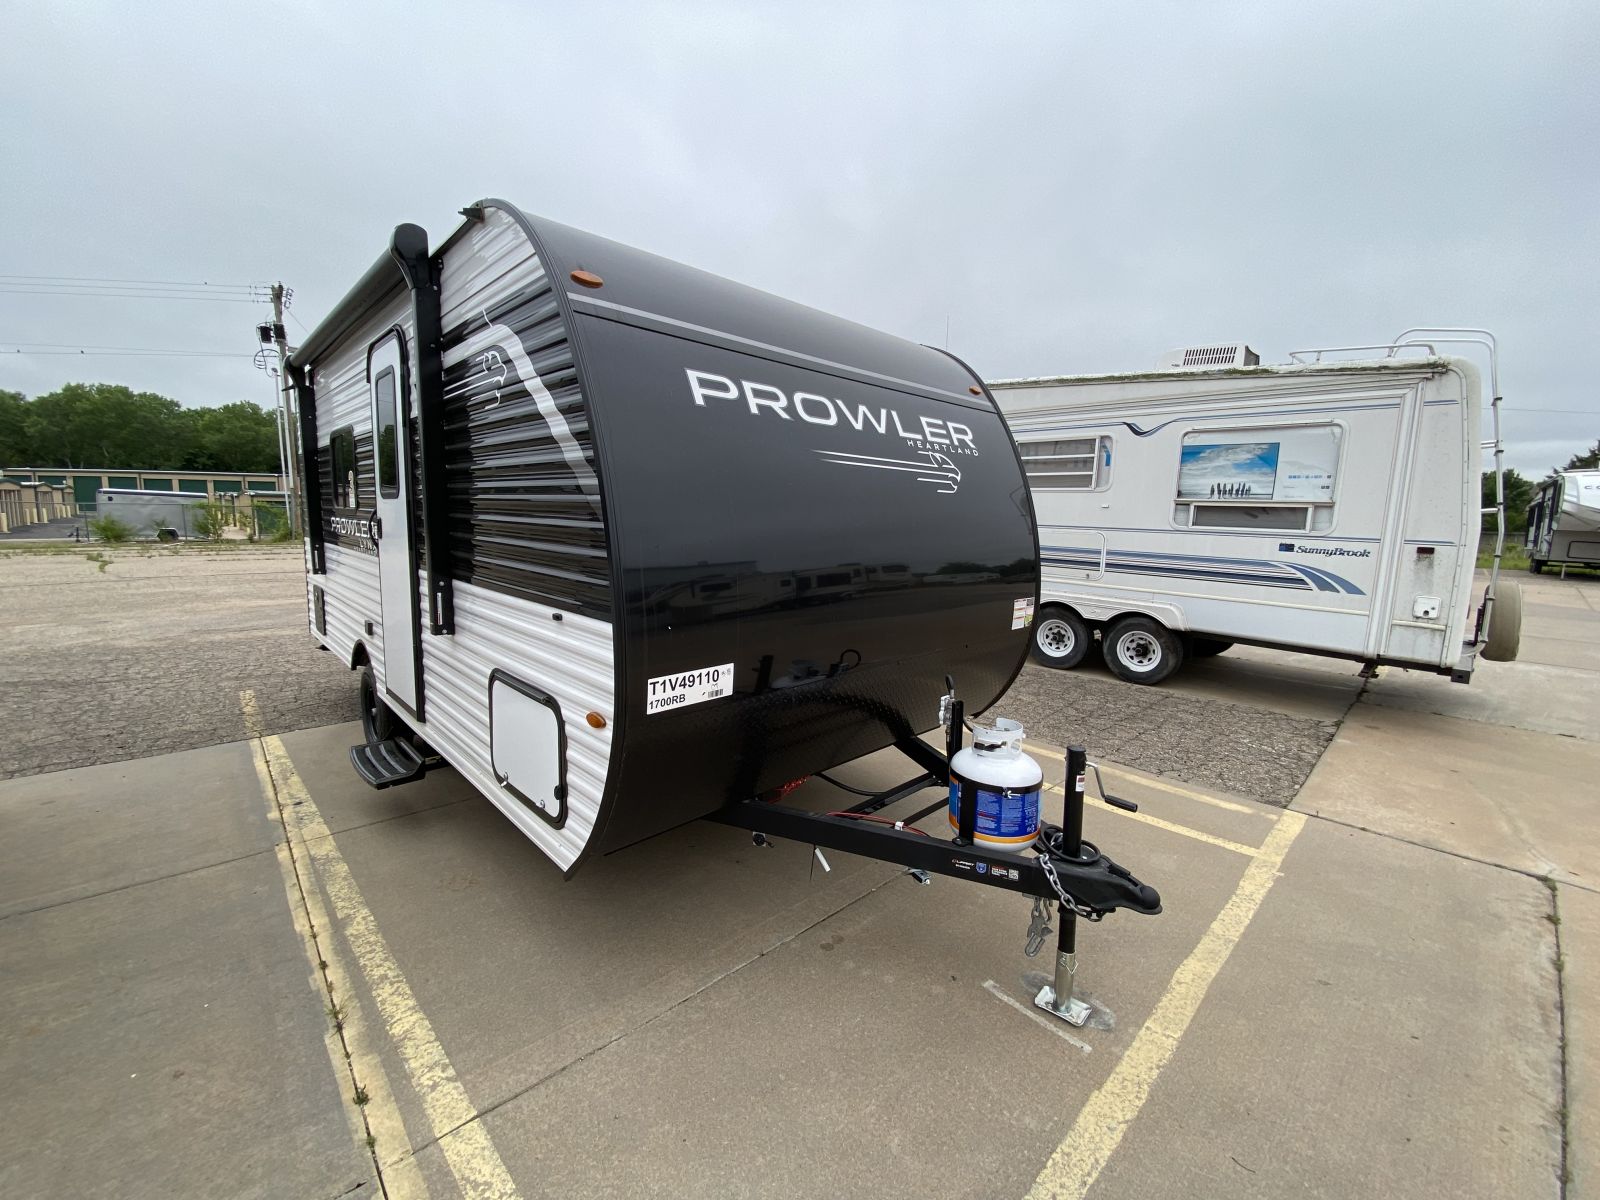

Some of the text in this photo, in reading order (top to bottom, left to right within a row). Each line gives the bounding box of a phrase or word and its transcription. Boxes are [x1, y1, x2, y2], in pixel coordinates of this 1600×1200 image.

[684, 368, 977, 450] PROWLER
[906, 439, 979, 457] HEARTLAND
[1296, 545, 1371, 558] SunnyBrook
[649, 669, 719, 695] T1V49110
[649, 693, 686, 709] 1700RB
